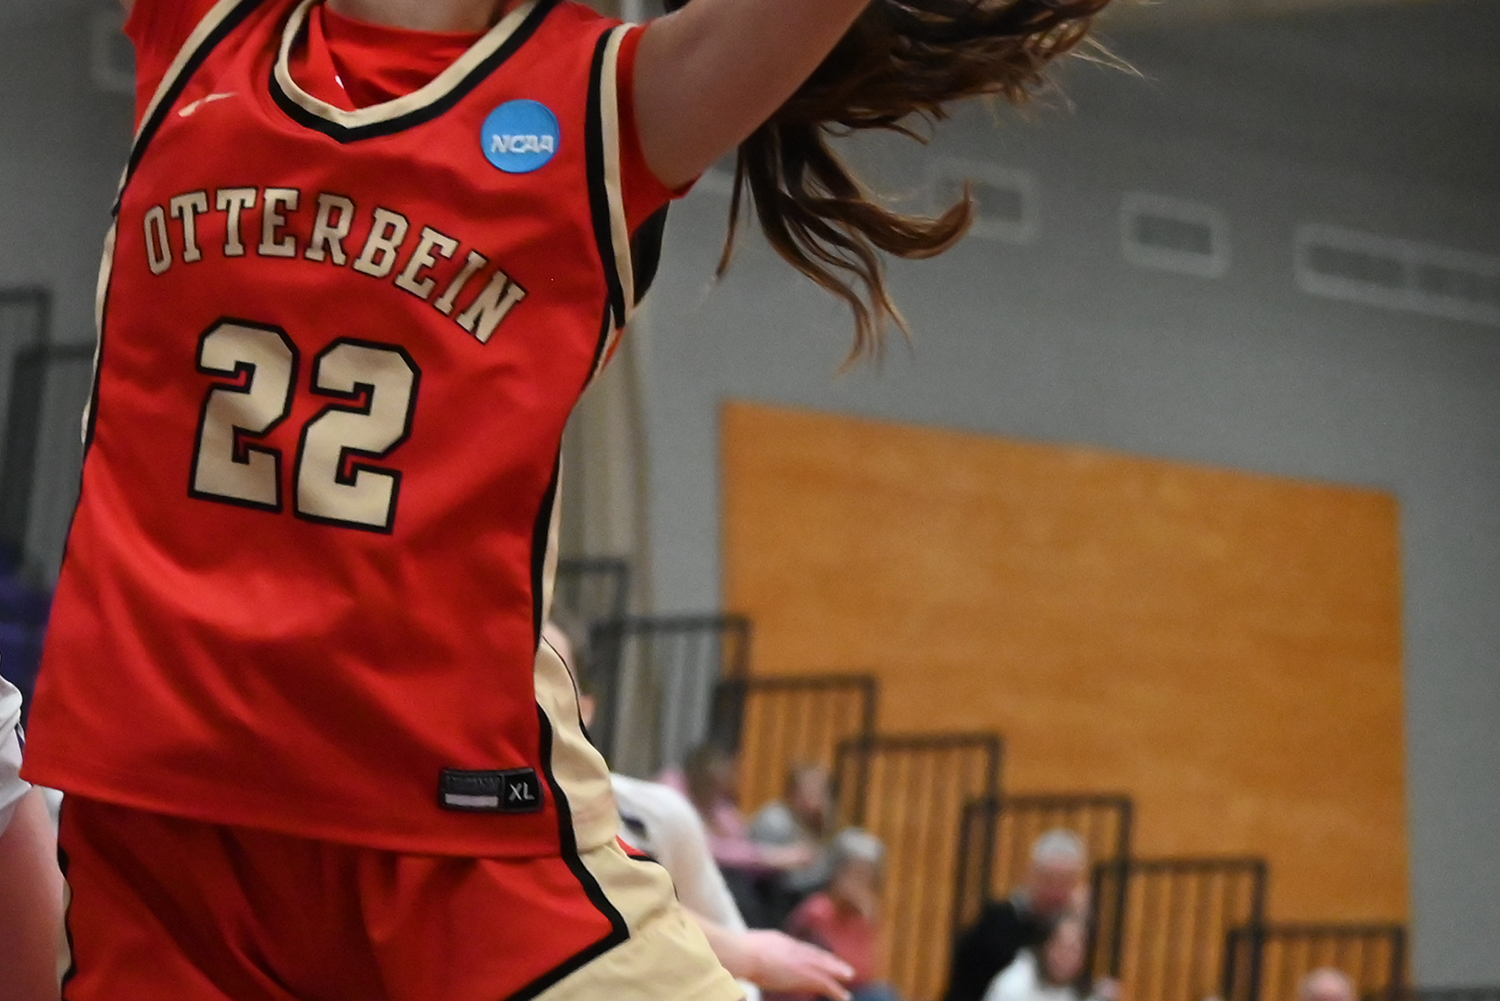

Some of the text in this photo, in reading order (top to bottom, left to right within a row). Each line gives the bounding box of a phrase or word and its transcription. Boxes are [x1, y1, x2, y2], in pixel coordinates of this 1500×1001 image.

[491, 134, 555, 154] NCAA
[142, 186, 530, 346] OTTERBEIN
[188, 316, 422, 535] 22
[508, 781, 536, 802] XL
